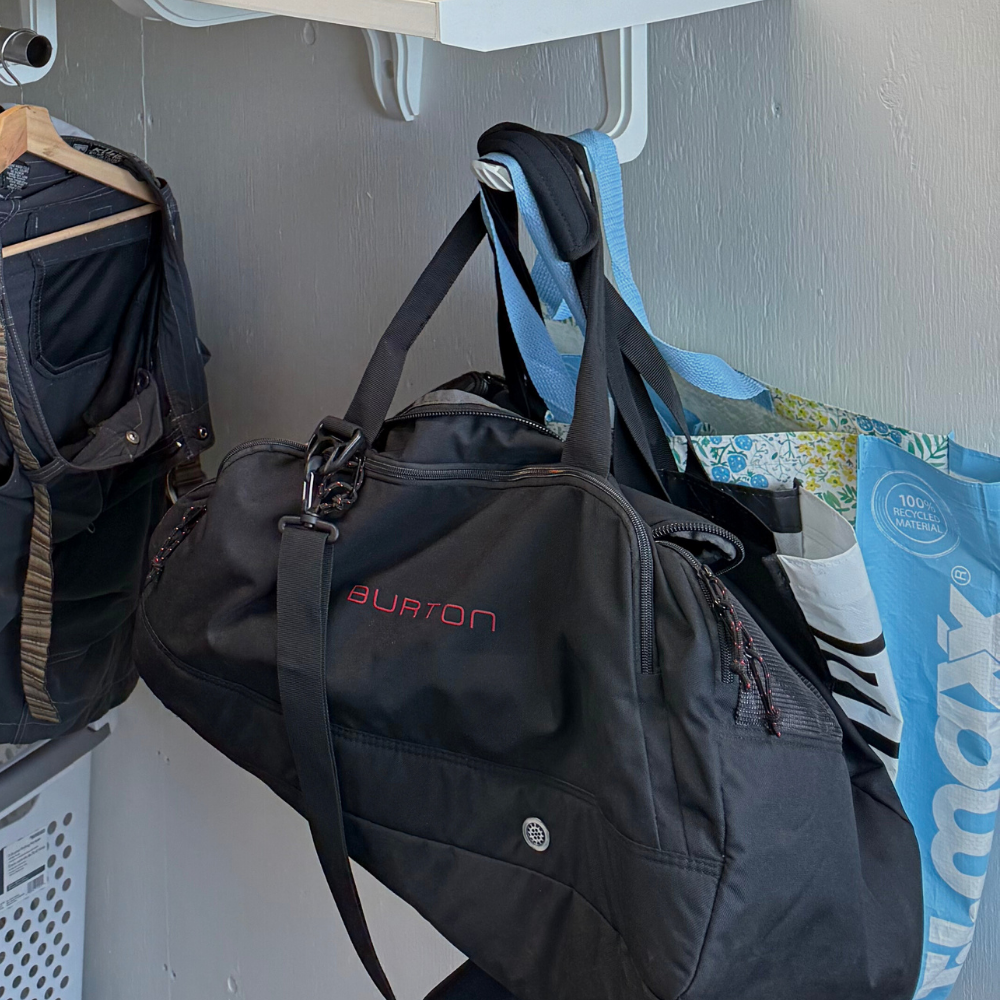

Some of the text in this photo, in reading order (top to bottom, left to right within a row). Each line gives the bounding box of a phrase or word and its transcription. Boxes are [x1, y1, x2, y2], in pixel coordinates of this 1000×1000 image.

[899, 495, 936, 513] 100%
[893, 507, 940, 523] RECYCLED
[896, 518, 943, 534] MATERIAL
[347, 584, 496, 633] BURTON
